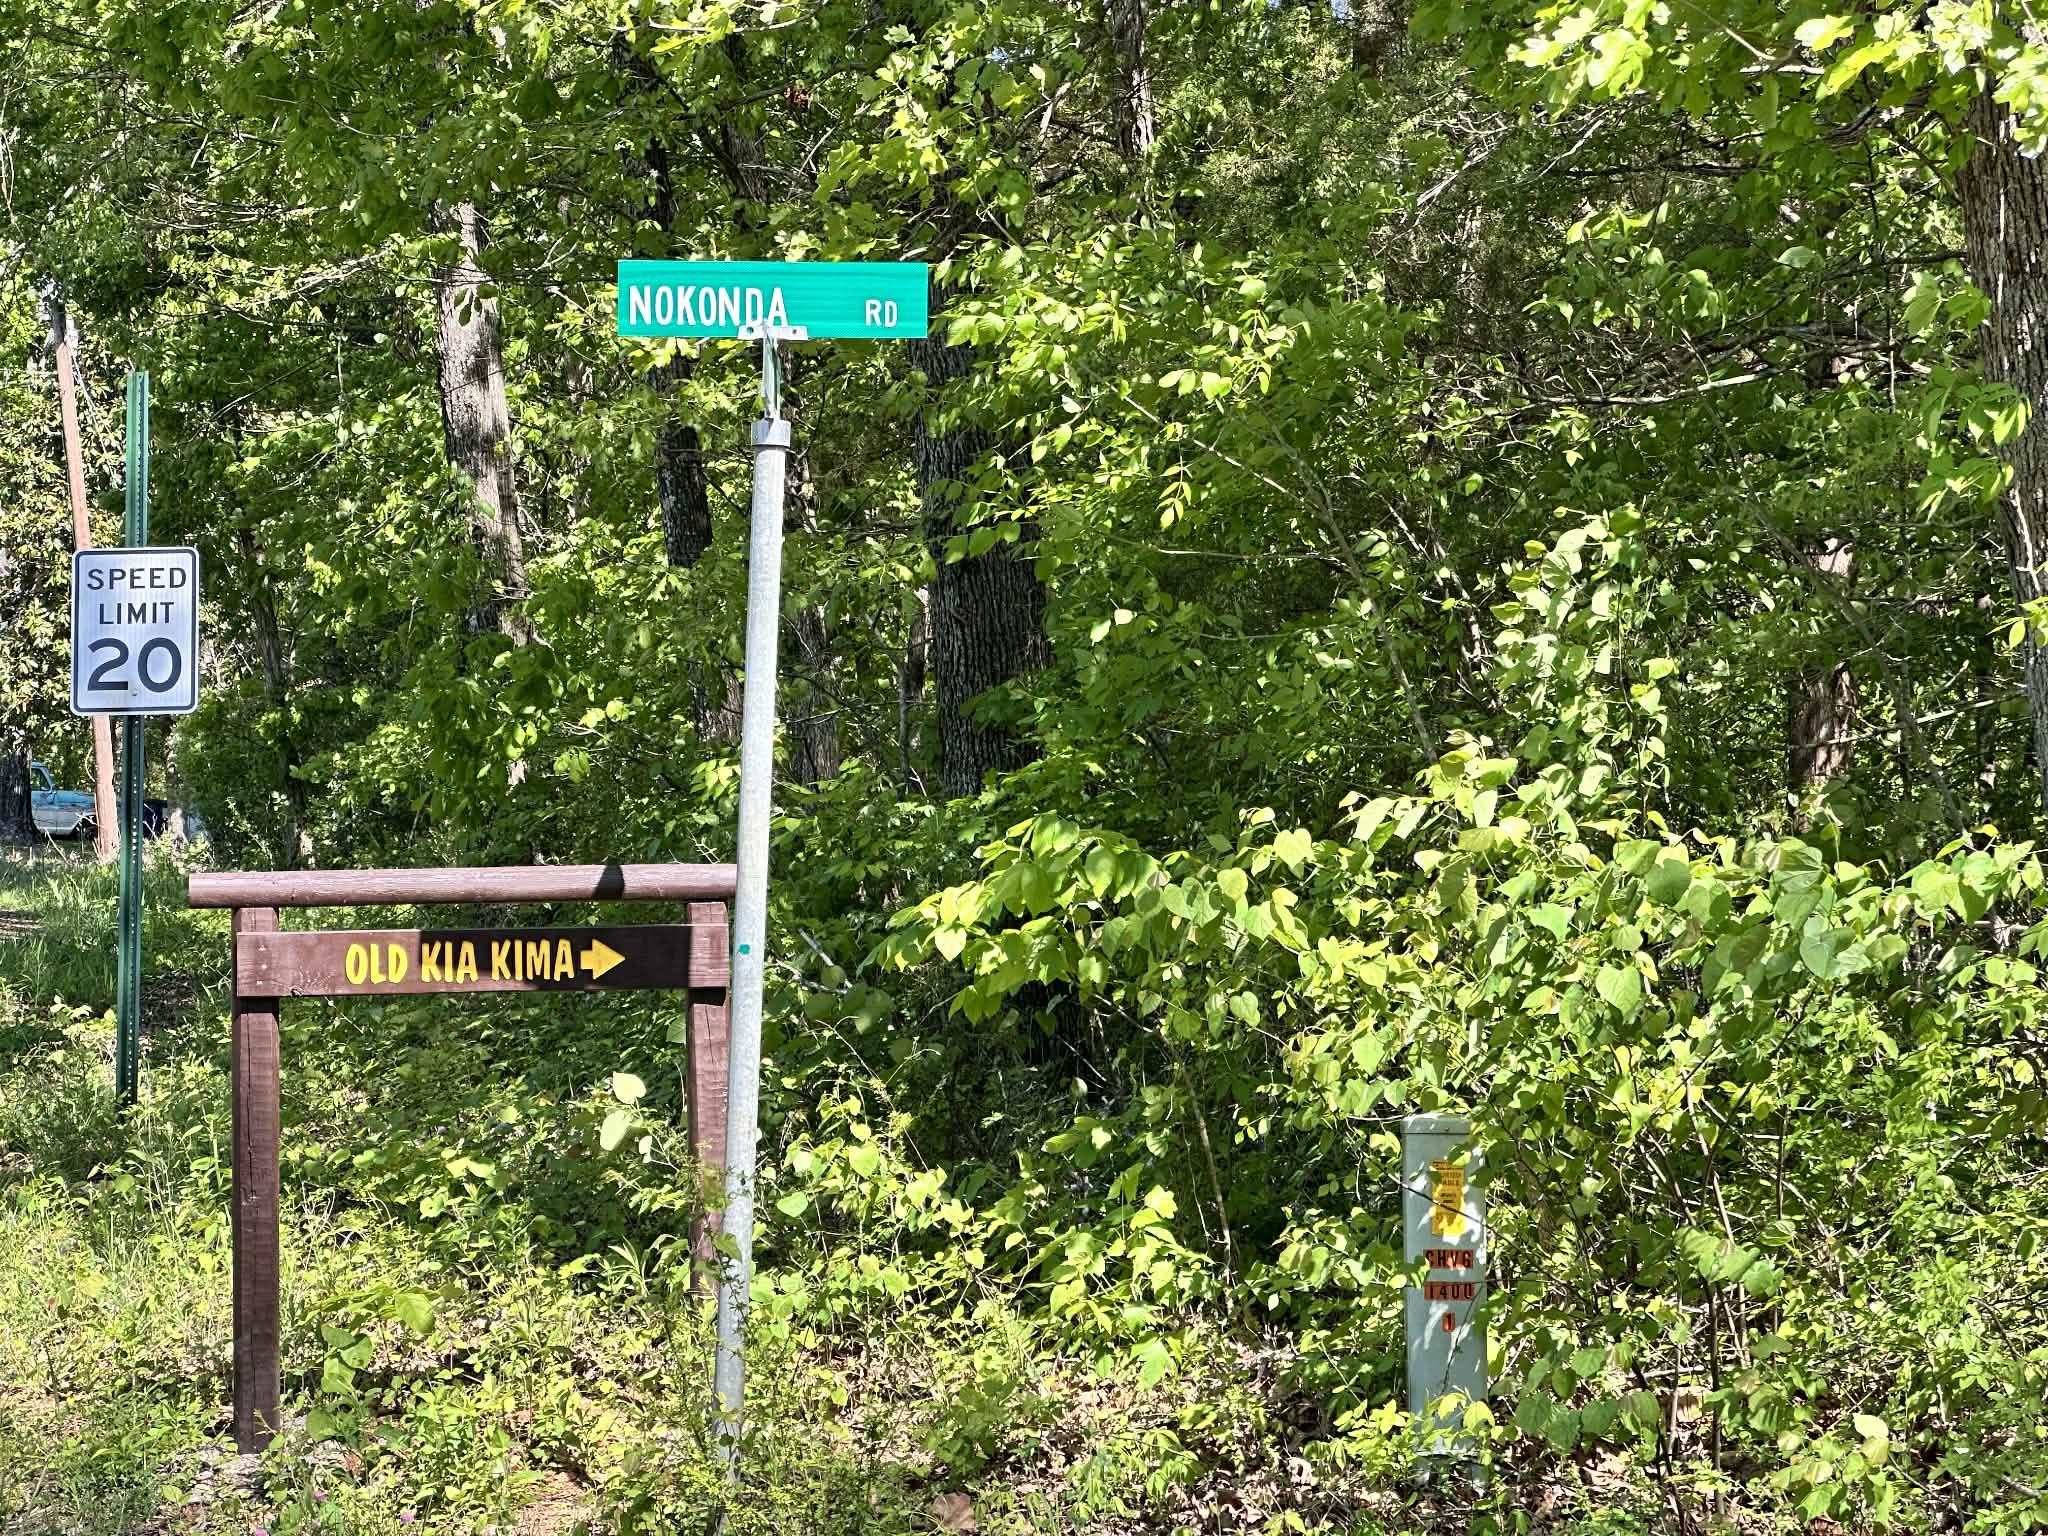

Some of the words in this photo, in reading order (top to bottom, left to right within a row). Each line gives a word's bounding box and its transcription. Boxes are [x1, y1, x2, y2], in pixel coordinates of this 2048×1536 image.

[628, 285, 788, 327] NOKONDA
[865, 299, 898, 328] RD
[87, 567, 187, 590] SPEED
[99, 601, 175, 625] LIMIT
[87, 637, 182, 693] 20
[345, 943, 408, 985] OLD
[421, 941, 479, 984] KIA
[491, 938, 575, 982] KIMA
